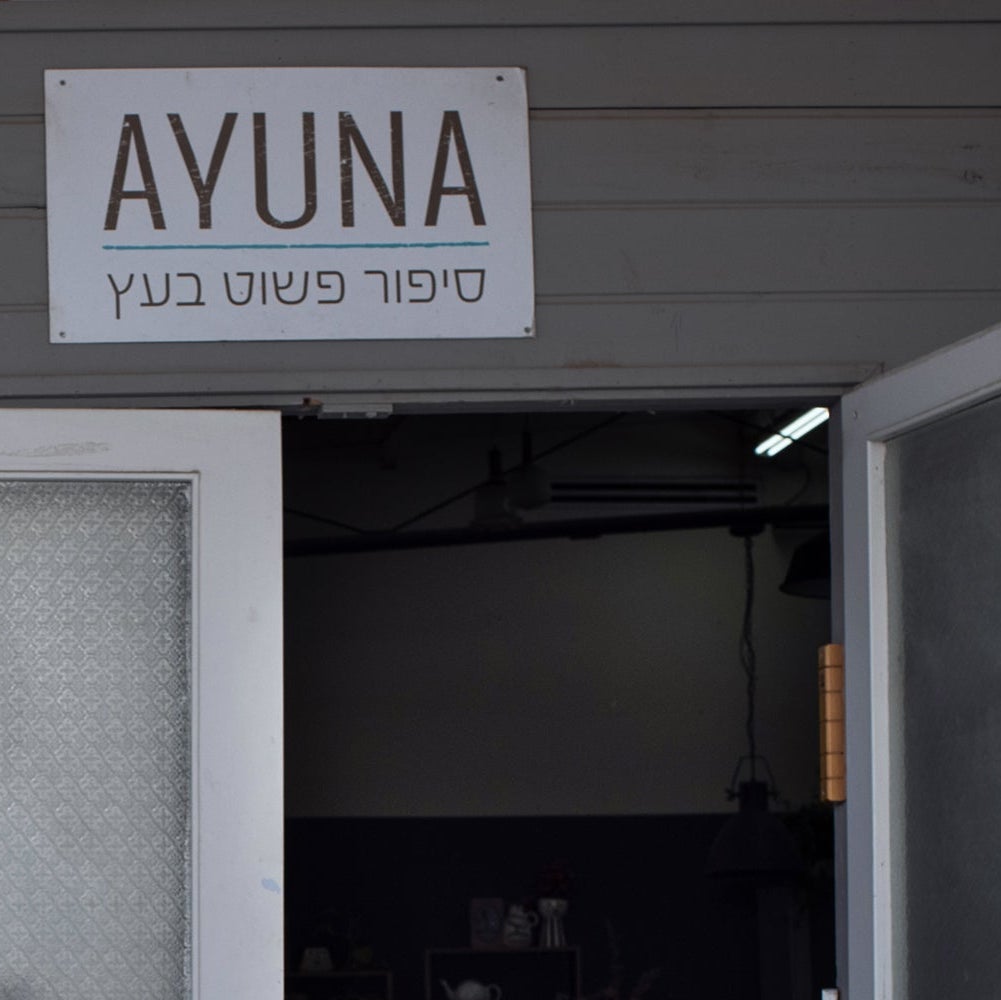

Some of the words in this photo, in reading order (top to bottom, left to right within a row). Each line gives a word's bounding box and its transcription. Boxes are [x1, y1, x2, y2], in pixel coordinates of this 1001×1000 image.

[103, 109, 487, 231] AYUNA
[107, 272, 206, 320] בעץ
[223, 270, 346, 306] פשוט
[363, 268, 486, 304] סיפור
